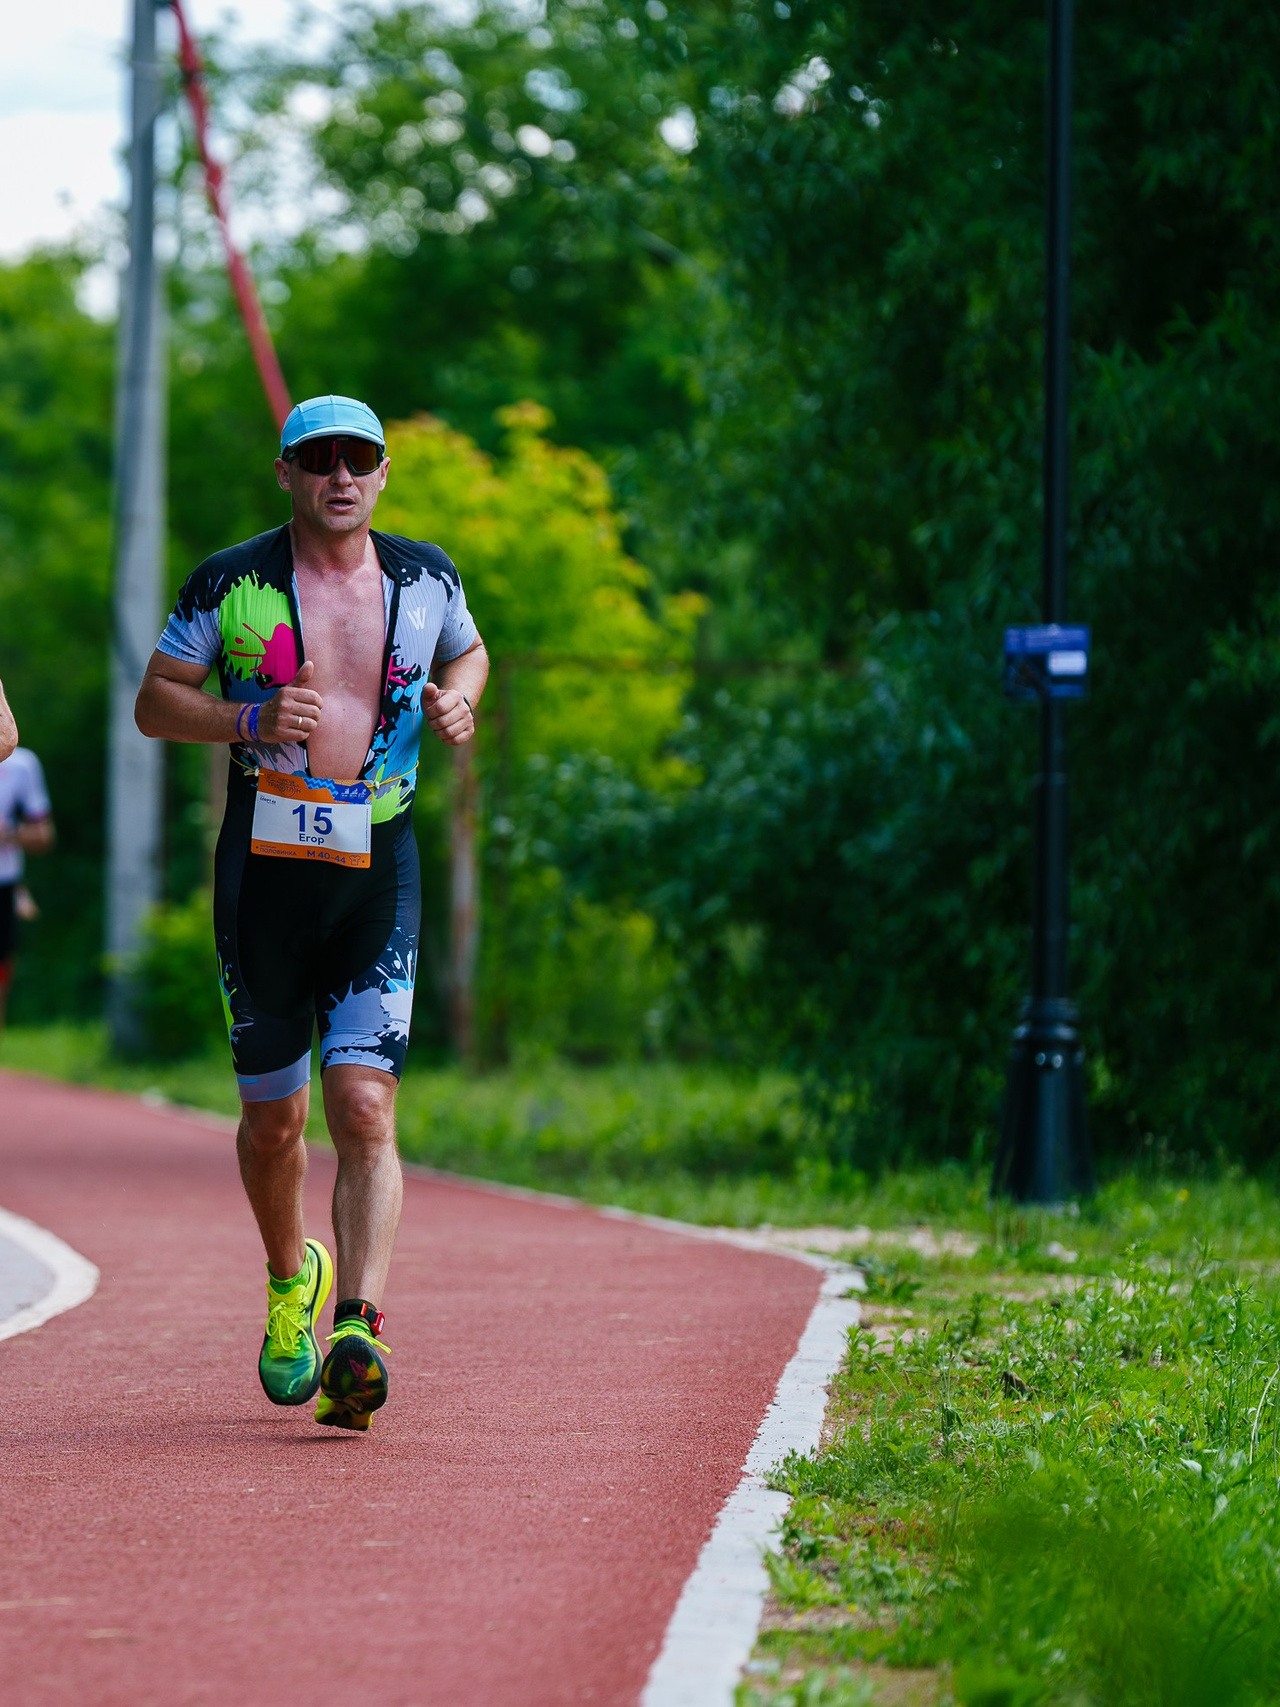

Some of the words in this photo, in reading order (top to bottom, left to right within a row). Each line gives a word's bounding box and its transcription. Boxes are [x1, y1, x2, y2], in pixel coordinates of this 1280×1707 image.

[292, 804, 332, 835] 15
[299, 833, 325, 845] Егор
[259, 847, 297, 856] ПОЛОВИНКА
[317, 851, 346, 864] 40-44
